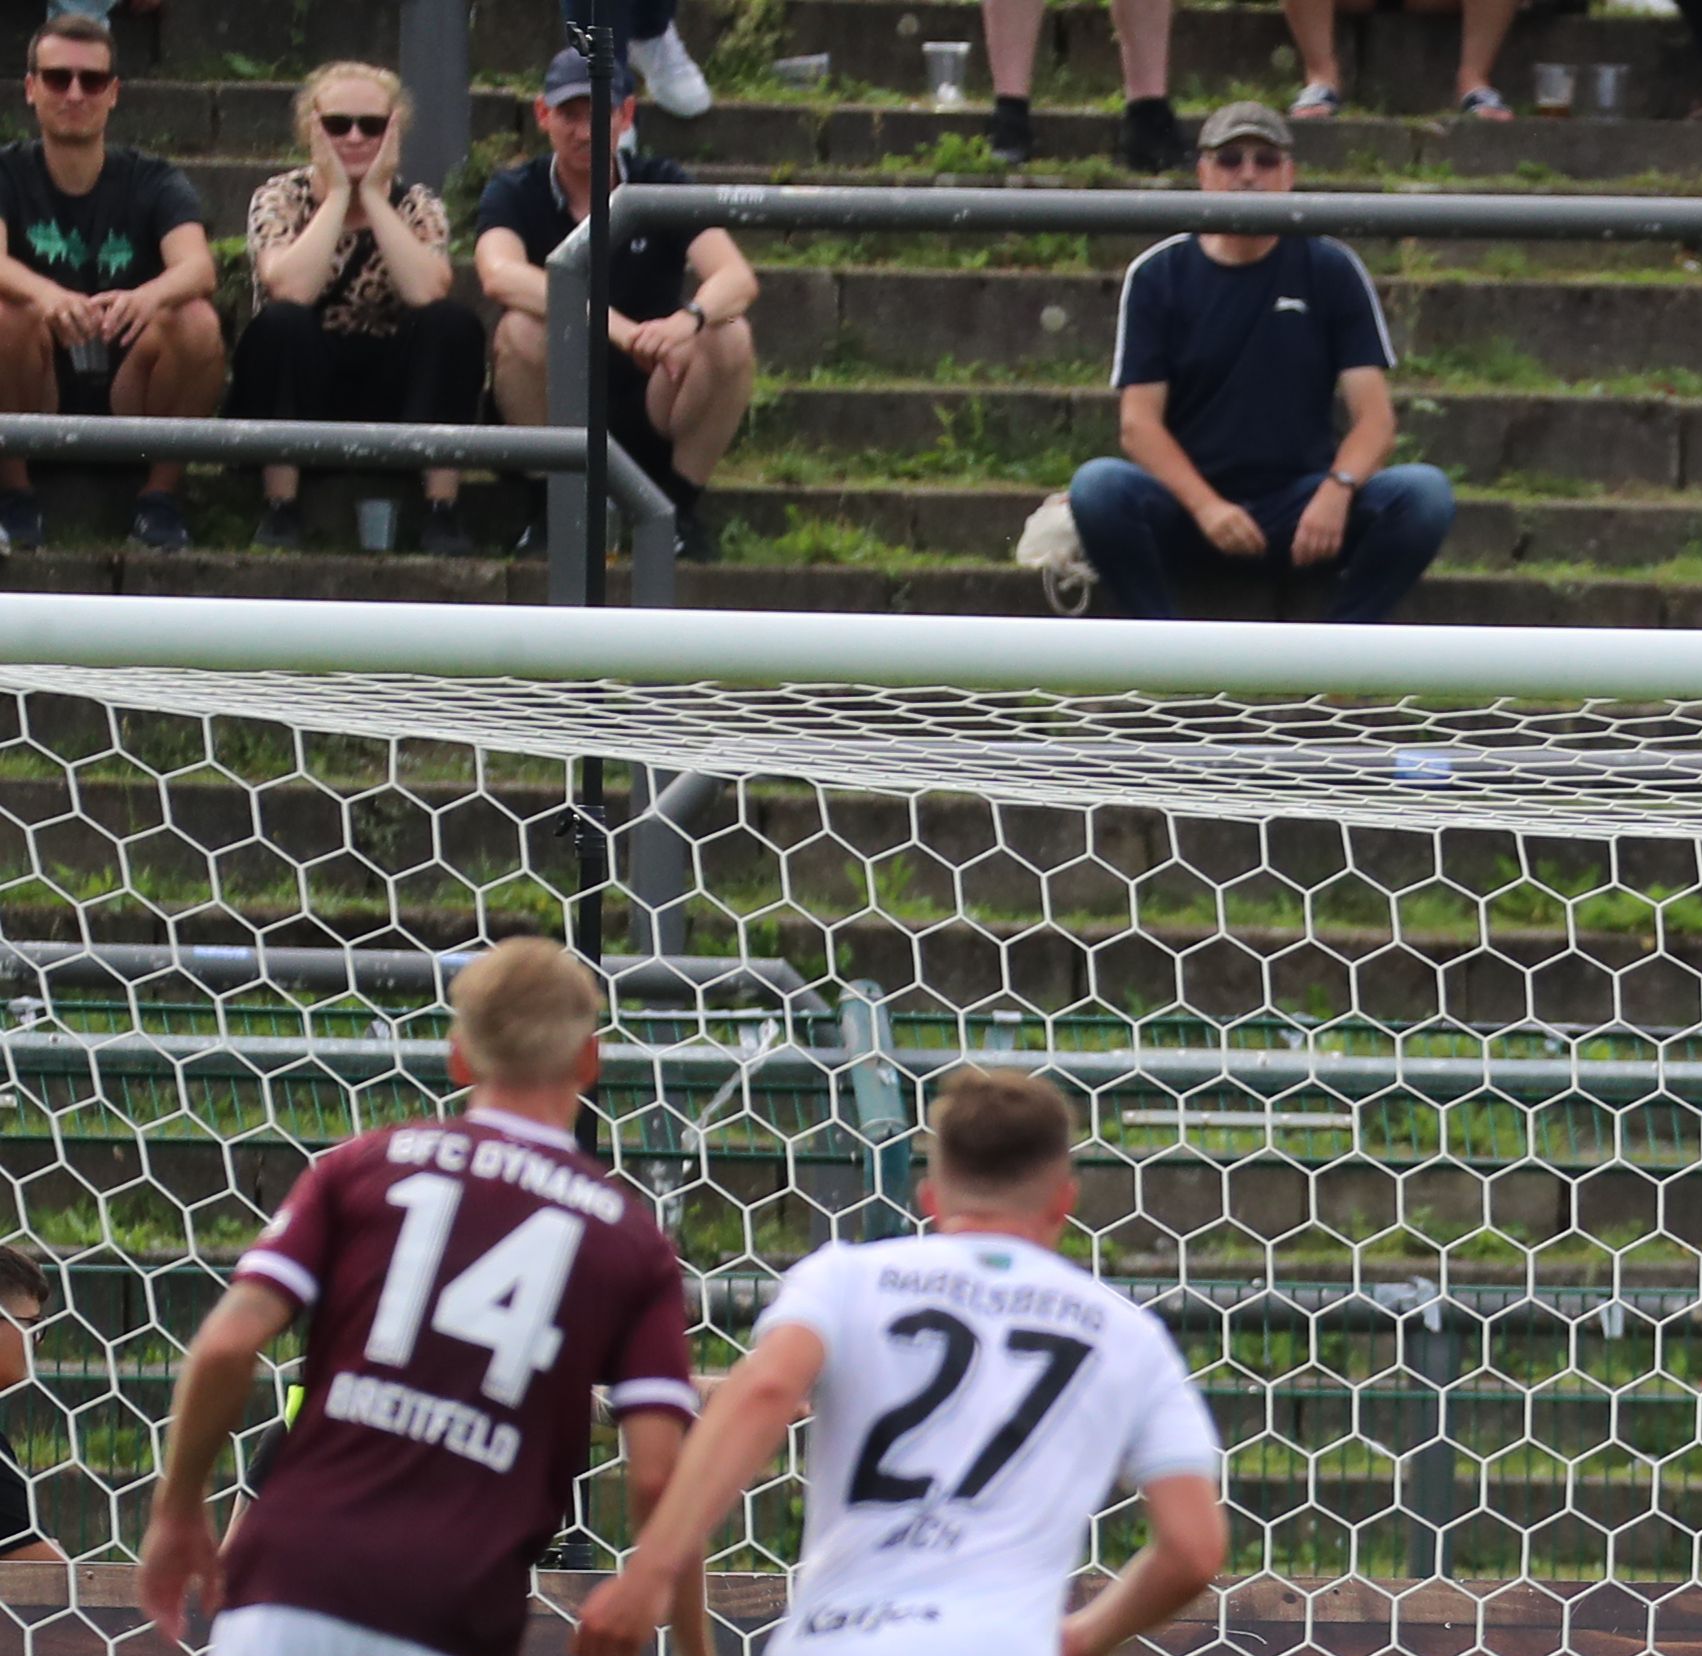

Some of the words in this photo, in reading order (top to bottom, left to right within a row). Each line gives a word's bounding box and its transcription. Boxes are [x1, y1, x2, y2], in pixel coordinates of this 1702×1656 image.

[470, 1140, 625, 1225] DYNAMO
[364, 1171, 586, 1409] 14
[324, 1371, 522, 1474] BREITFELD
[848, 1308, 1096, 1505] 27
